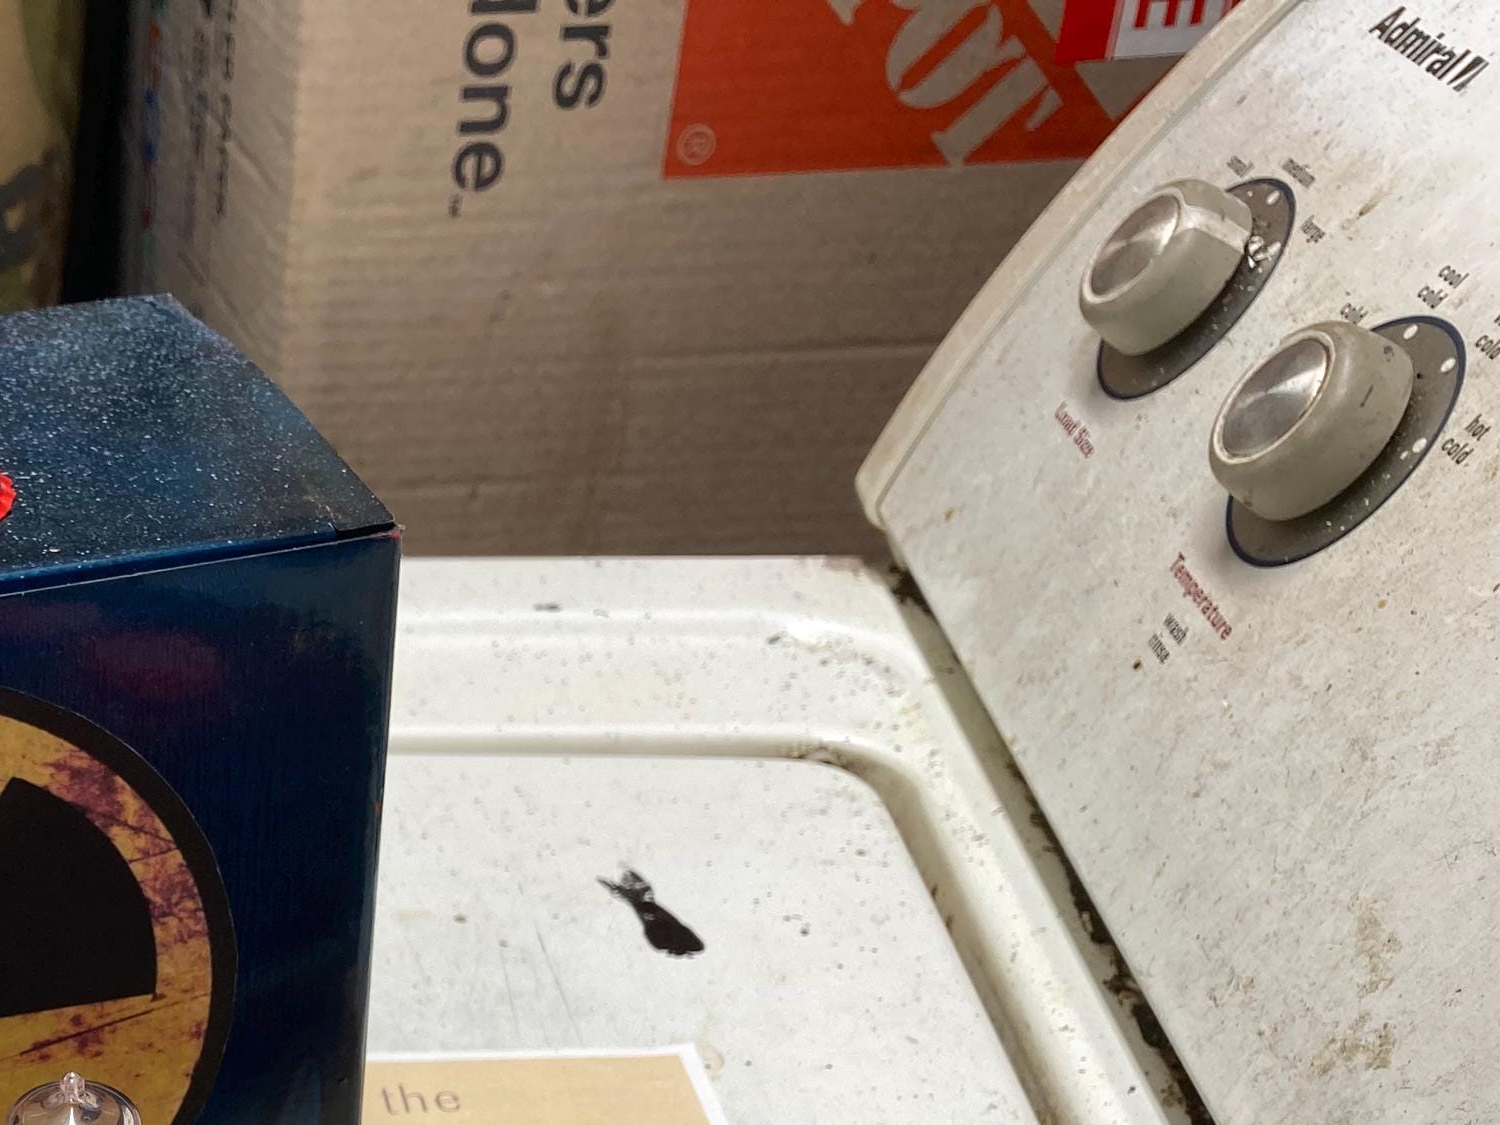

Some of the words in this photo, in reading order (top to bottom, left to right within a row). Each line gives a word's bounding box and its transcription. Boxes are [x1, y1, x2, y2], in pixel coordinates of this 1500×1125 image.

[1441, 438, 1475, 465] cold
[1170, 551, 1233, 641] Temperature
[381, 1082, 461, 1116] the
